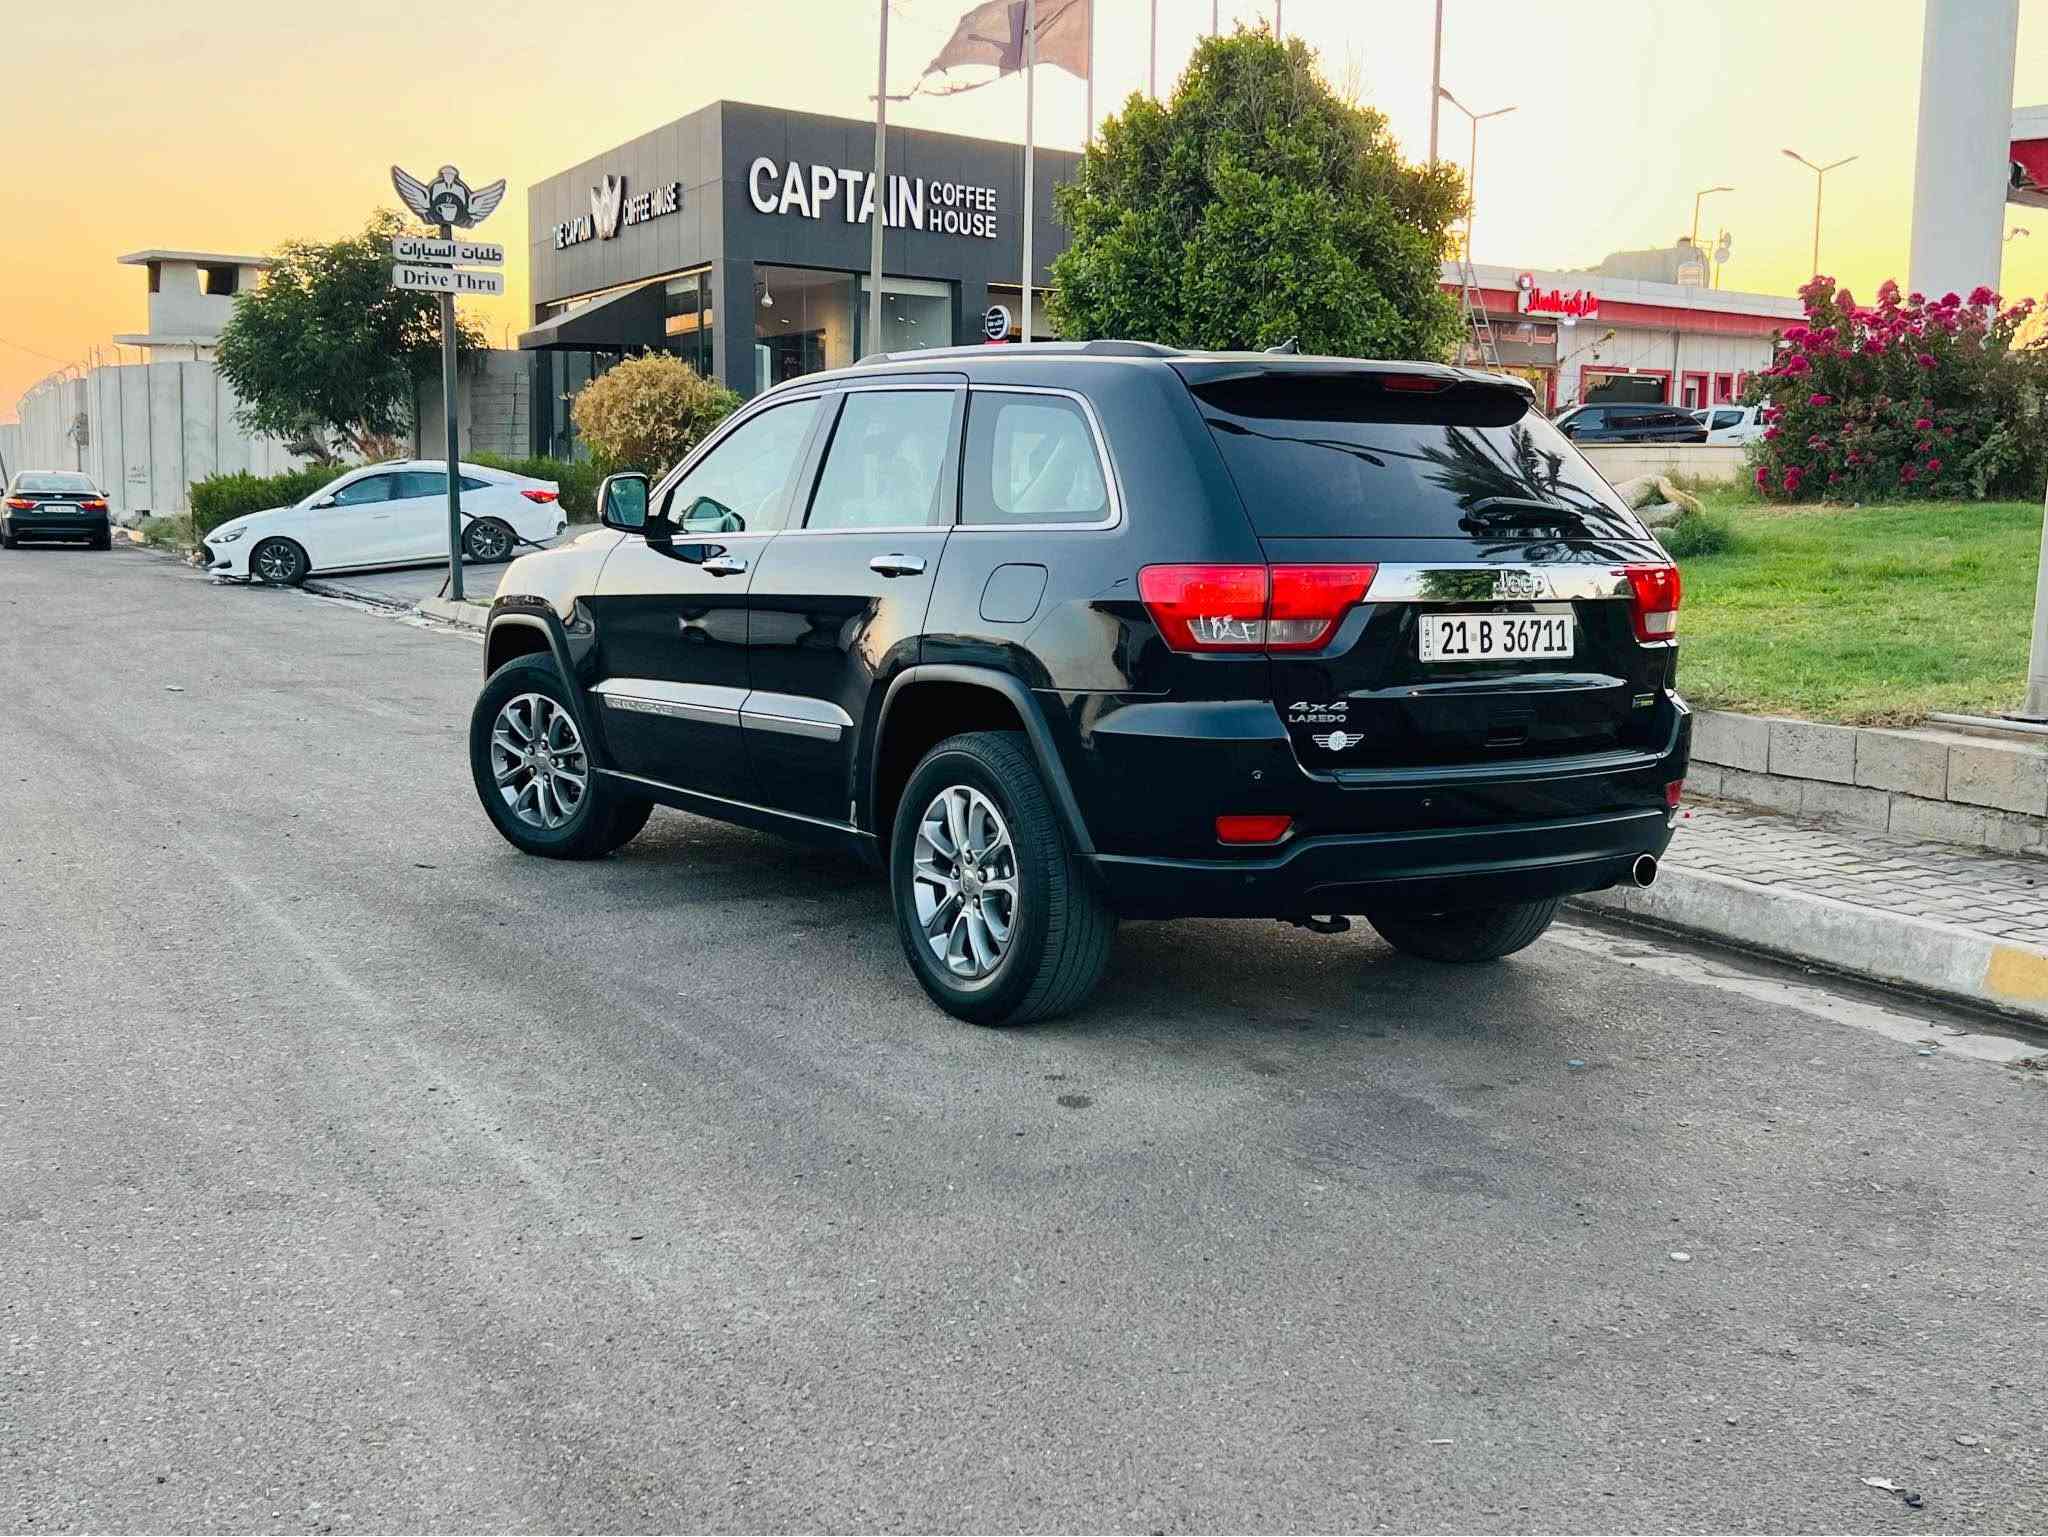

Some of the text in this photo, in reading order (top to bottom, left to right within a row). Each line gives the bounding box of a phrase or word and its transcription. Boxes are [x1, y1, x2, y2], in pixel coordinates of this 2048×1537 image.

[623, 192, 650, 226] COFFEE
[650, 181, 678, 219] HOUSE
[749, 156, 924, 230] CAPTAIN
[929, 180, 997, 211] COFFEE
[929, 208, 997, 239] HOUSE
[399, 242, 503, 264] طلبات السيارات
[403, 270, 497, 291] Drive Thru
[1493, 569, 1546, 598] Jeep
[1441, 620, 1470, 655] 21
[1479, 620, 1493, 654] B
[1503, 619, 1568, 653] 36711
[1287, 714, 1347, 723] LAREDO
